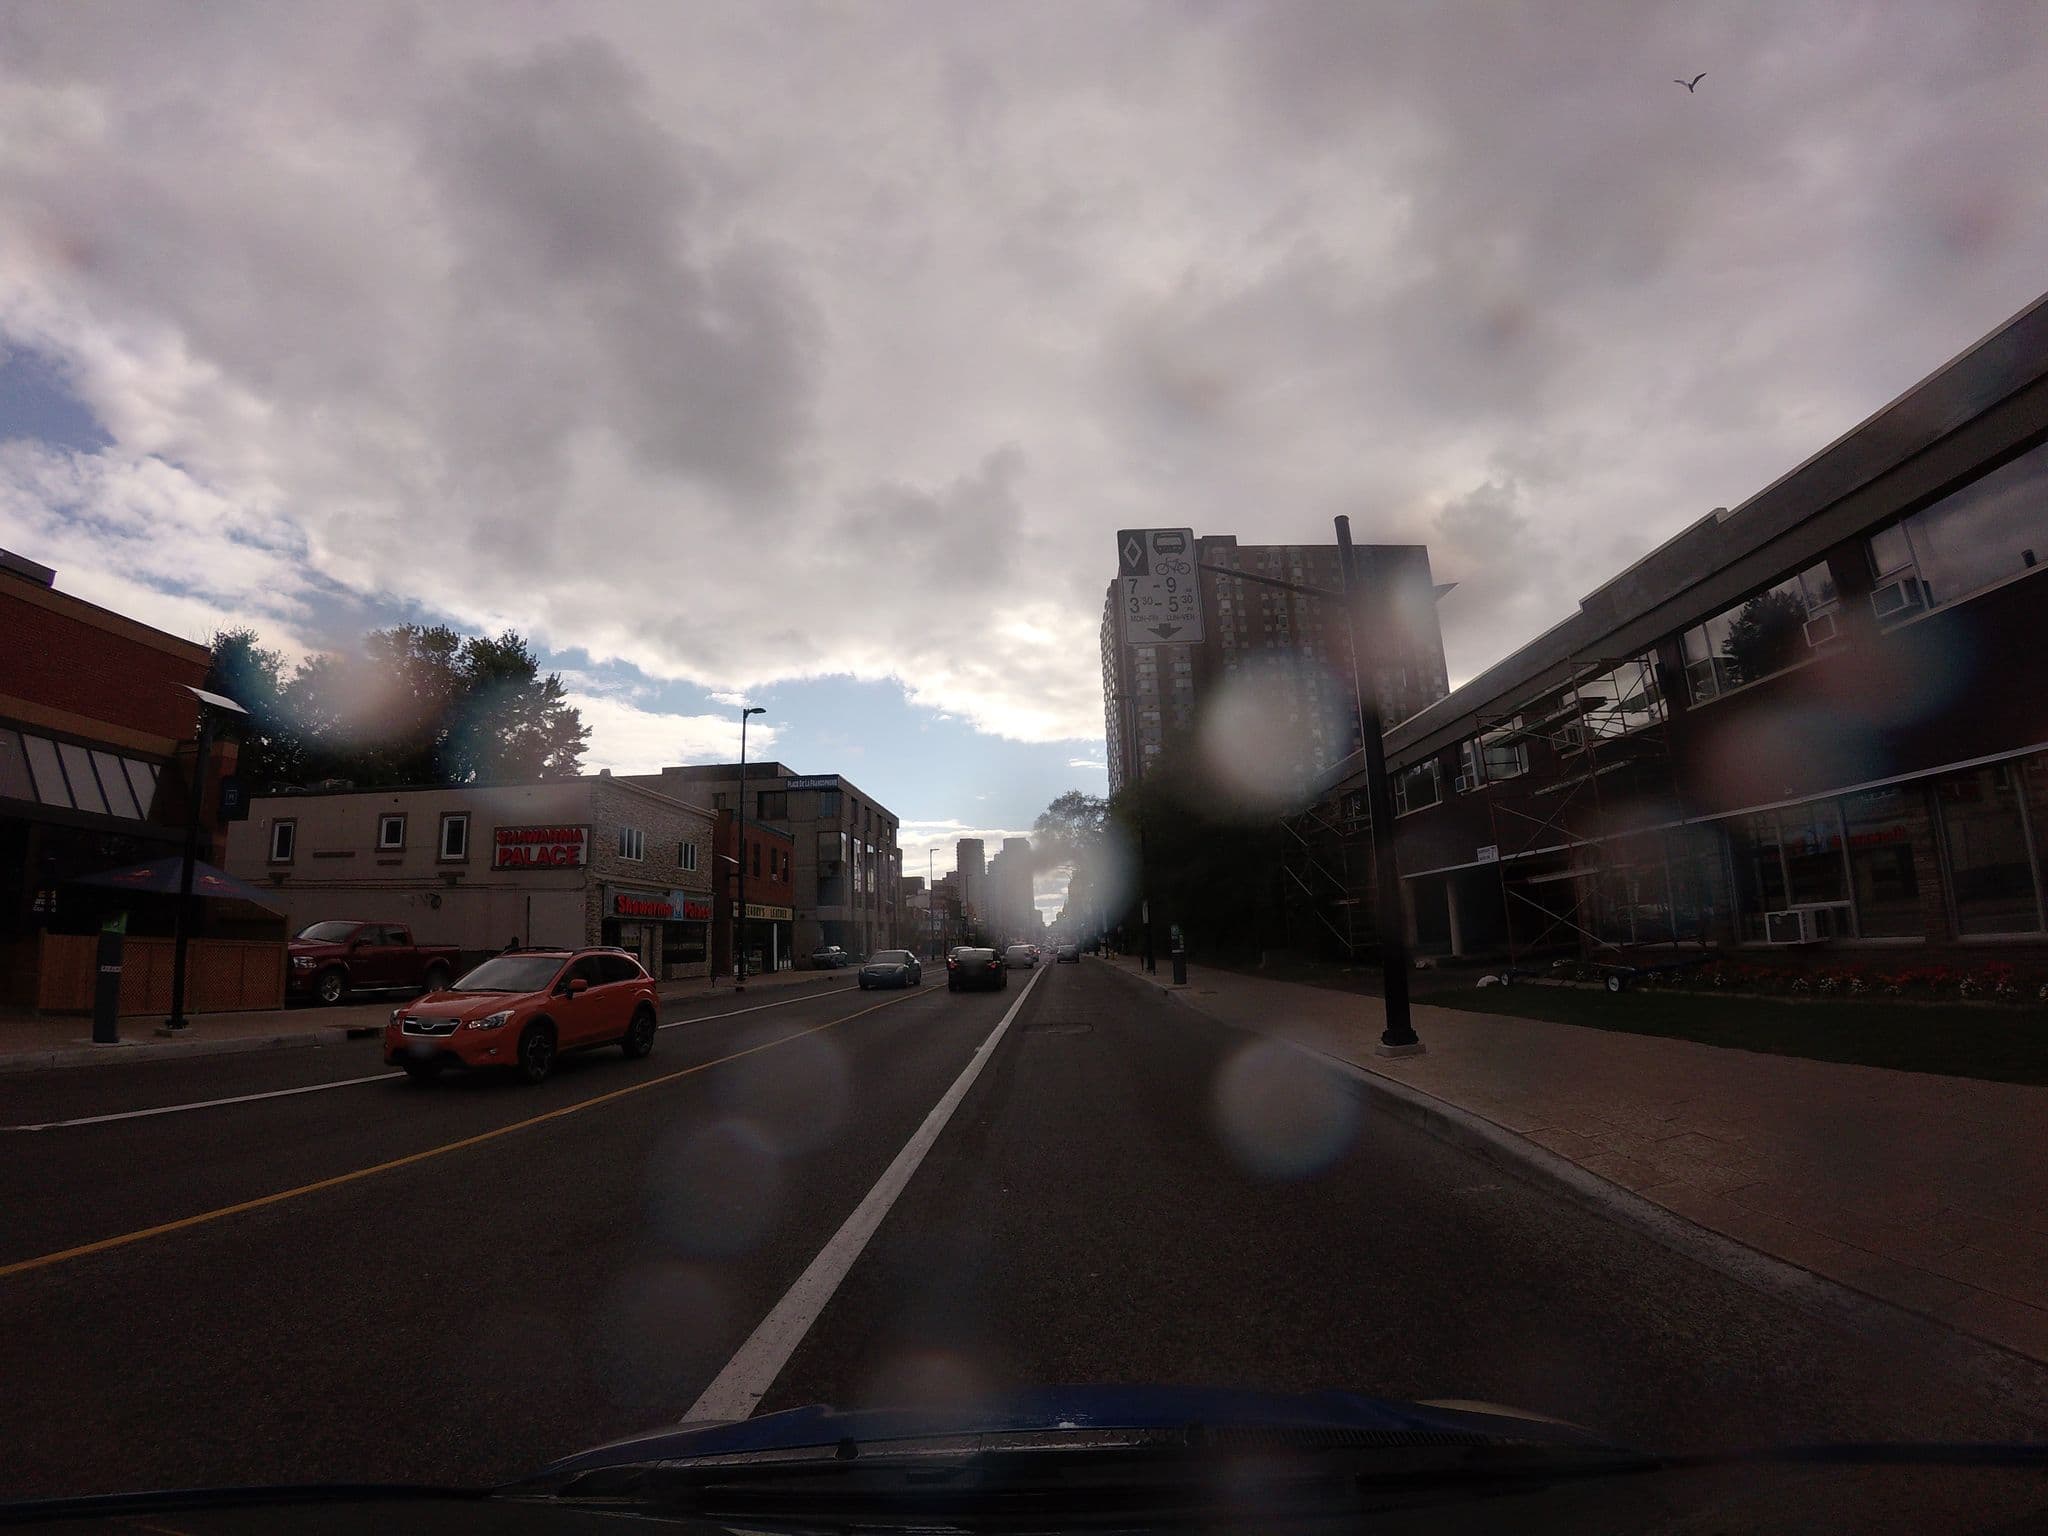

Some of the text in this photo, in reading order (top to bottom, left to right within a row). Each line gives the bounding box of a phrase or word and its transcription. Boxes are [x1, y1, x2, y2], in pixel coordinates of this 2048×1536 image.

[1129, 579, 1138, 594] 7
[1167, 577, 1176, 593] 9
[1130, 598, 1139, 613] 3
[1168, 596, 1179, 612] 5
[499, 845, 580, 865] PALACE
